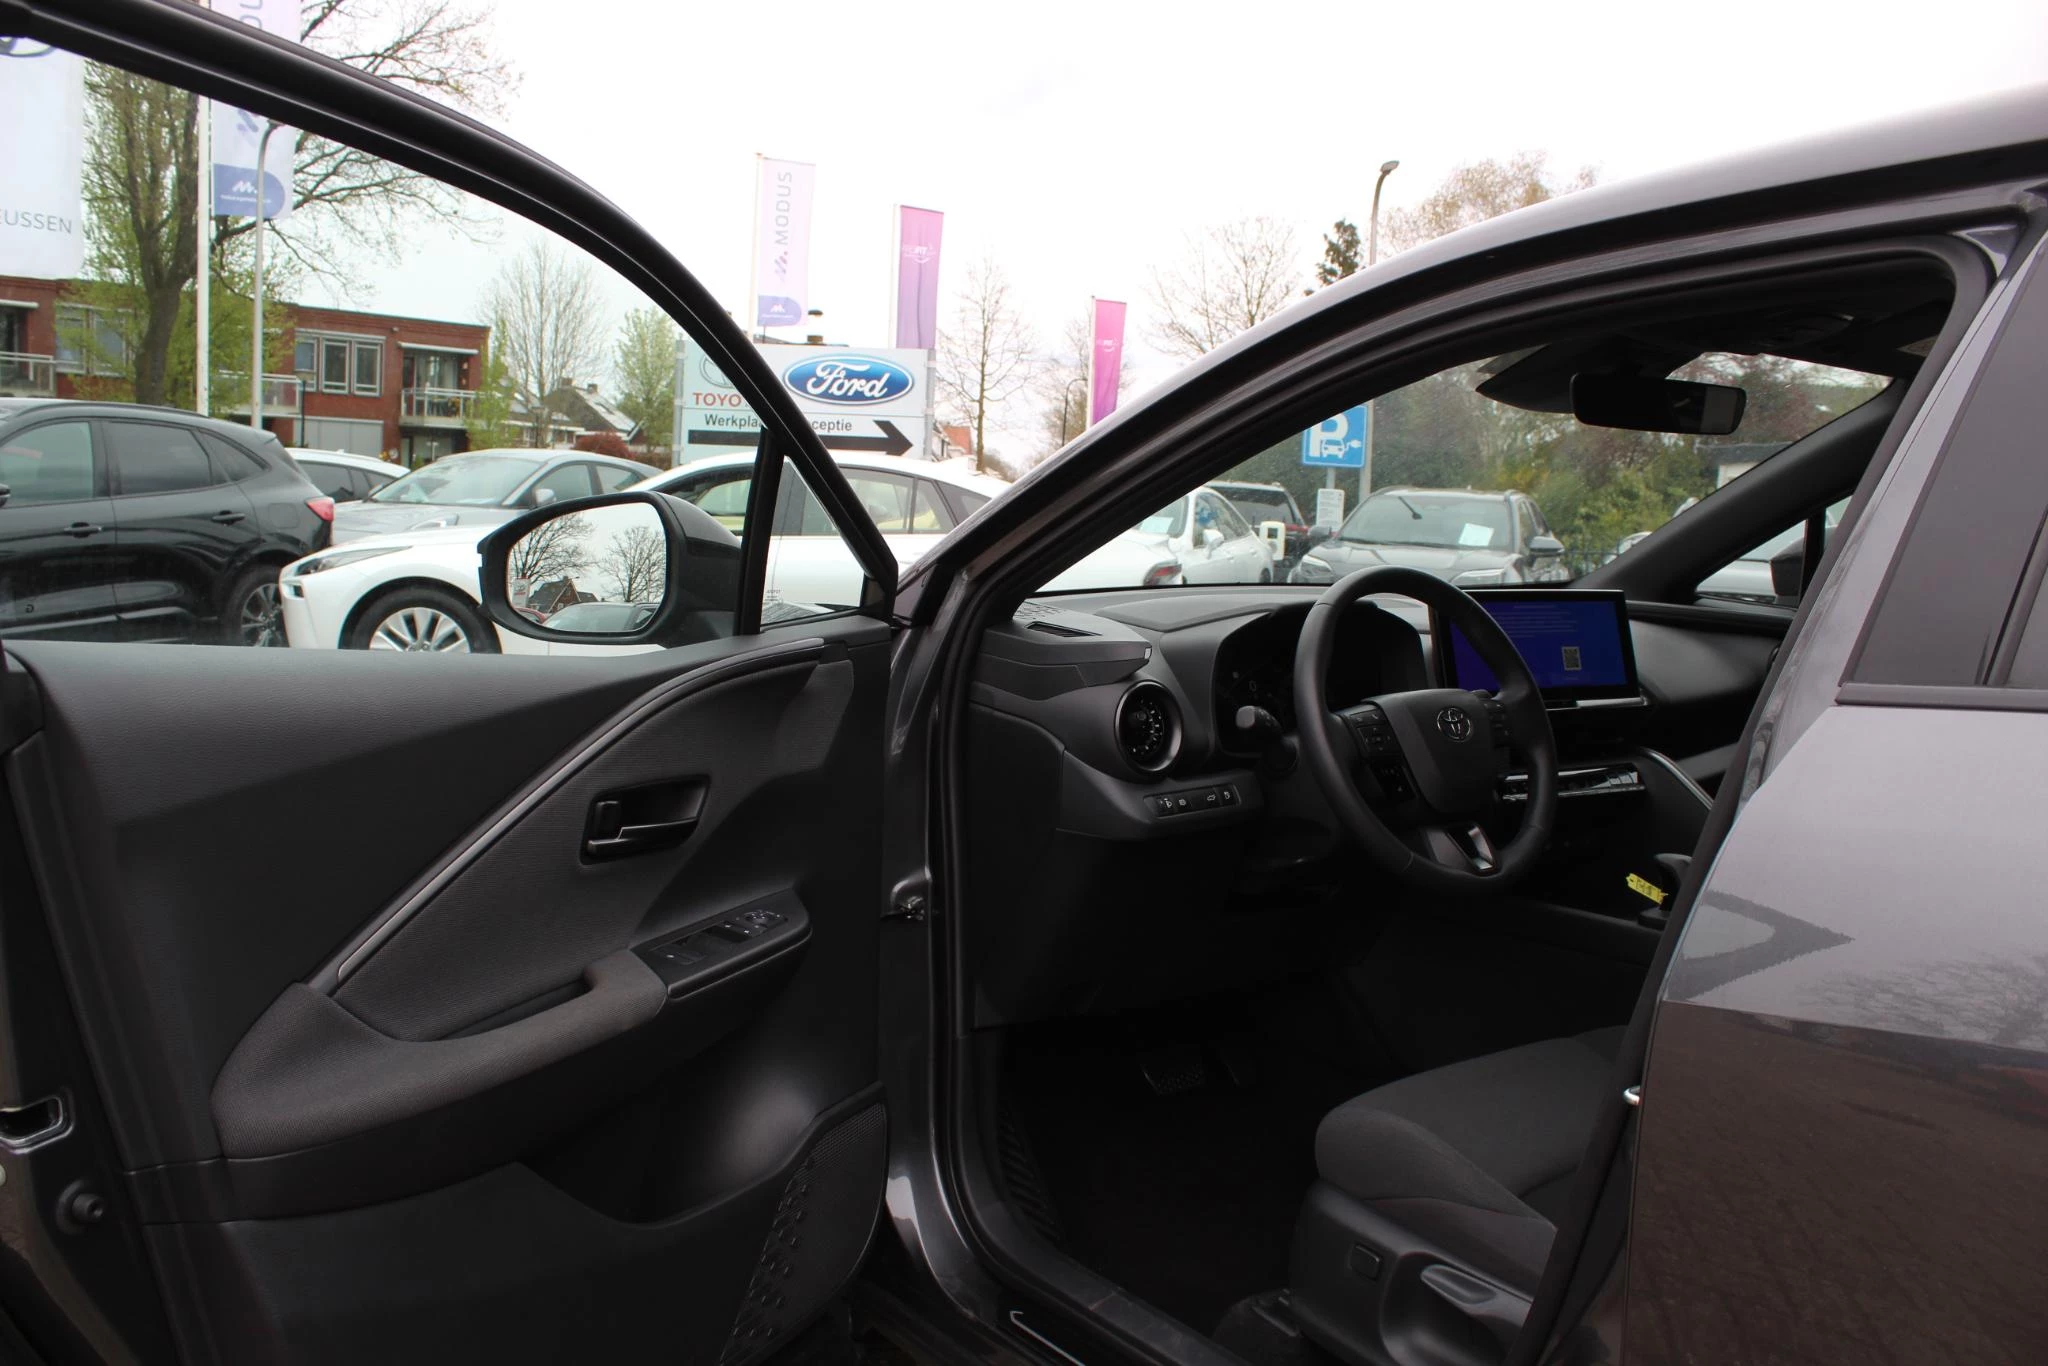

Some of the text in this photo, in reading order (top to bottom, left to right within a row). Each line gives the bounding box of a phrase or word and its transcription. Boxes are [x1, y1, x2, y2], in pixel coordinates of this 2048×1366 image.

[774, 171, 792, 246] MODUS
[0, 209, 72, 234] USSEN
[806, 361, 890, 398] Ford
[692, 392, 746, 408] TOYO
[705, 413, 853, 433] Werkpla ceptie
